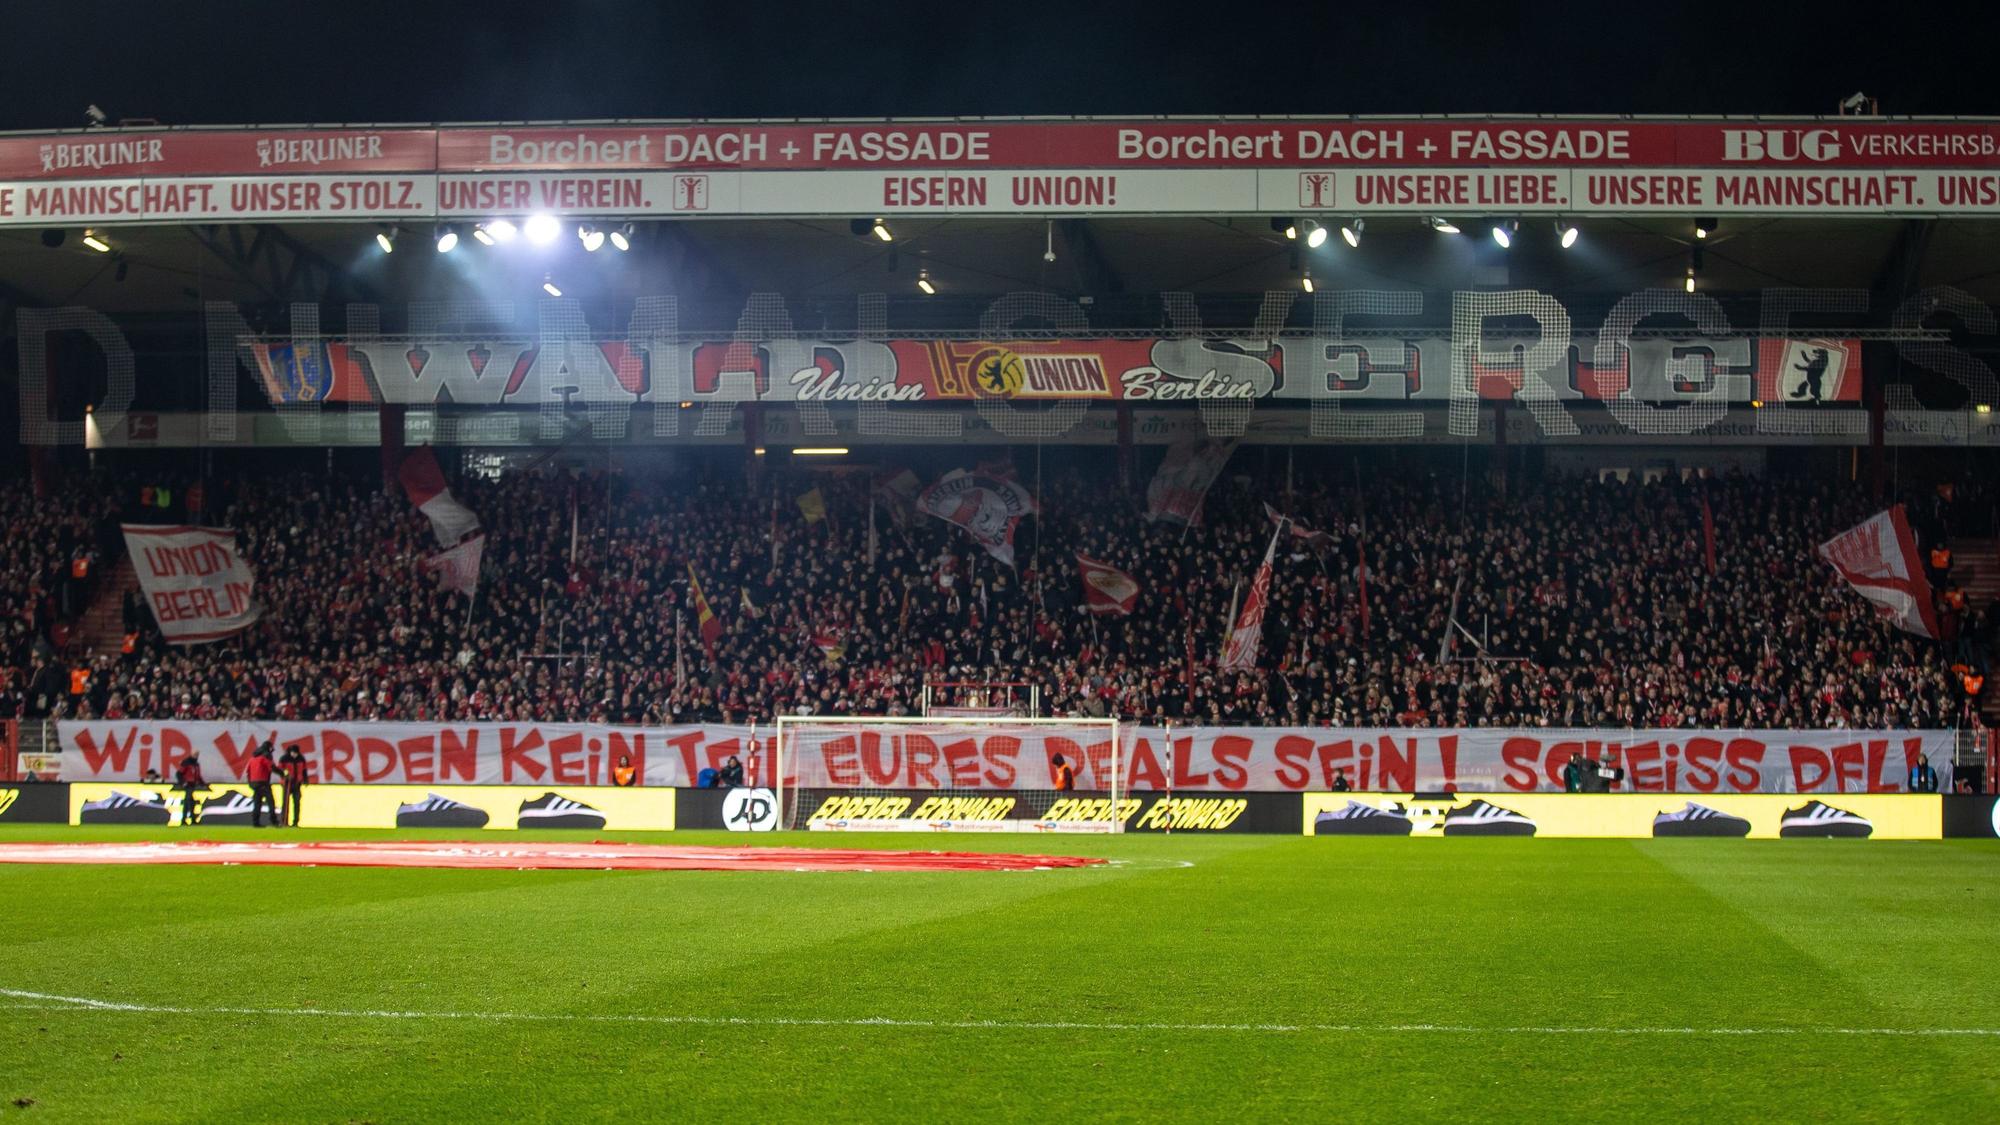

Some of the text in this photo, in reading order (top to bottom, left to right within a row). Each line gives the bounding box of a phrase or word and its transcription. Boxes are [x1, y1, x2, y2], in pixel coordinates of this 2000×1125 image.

[57, 139, 163, 169] BERLINER
[274, 135, 383, 165] BERLINER
[490, 134, 650, 164] Borchert
[664, 133, 767, 163] DACH
[813, 132, 990, 161] FASSADE
[1118, 129, 1283, 159] Borchert
[1298, 130, 1404, 159] DACH
[1451, 130, 1630, 160] FASSADE
[1721, 129, 2000, 161] BUG VERKEHRSB
[25, 183, 218, 217] MANNSCHAFT.
[230, 182, 321, 212] UNSER
[330, 181, 422, 211] STOLZ.
[439, 178, 652, 210] UNSER VEREIN.
[883, 176, 1116, 206] EISERN UNION!
[1355, 175, 1567, 204] UNSERE LIEBE.
[1589, 175, 2000, 207] UNSERE MANNSCHAFT. UNS
[789, 366, 926, 401] Union
[1120, 367, 1258, 400] Berlin
[1023, 357, 1108, 392] UNION
[144, 539, 234, 577] UNION
[153, 581, 251, 623] BERLIN
[821, 731, 1021, 789] EURES
